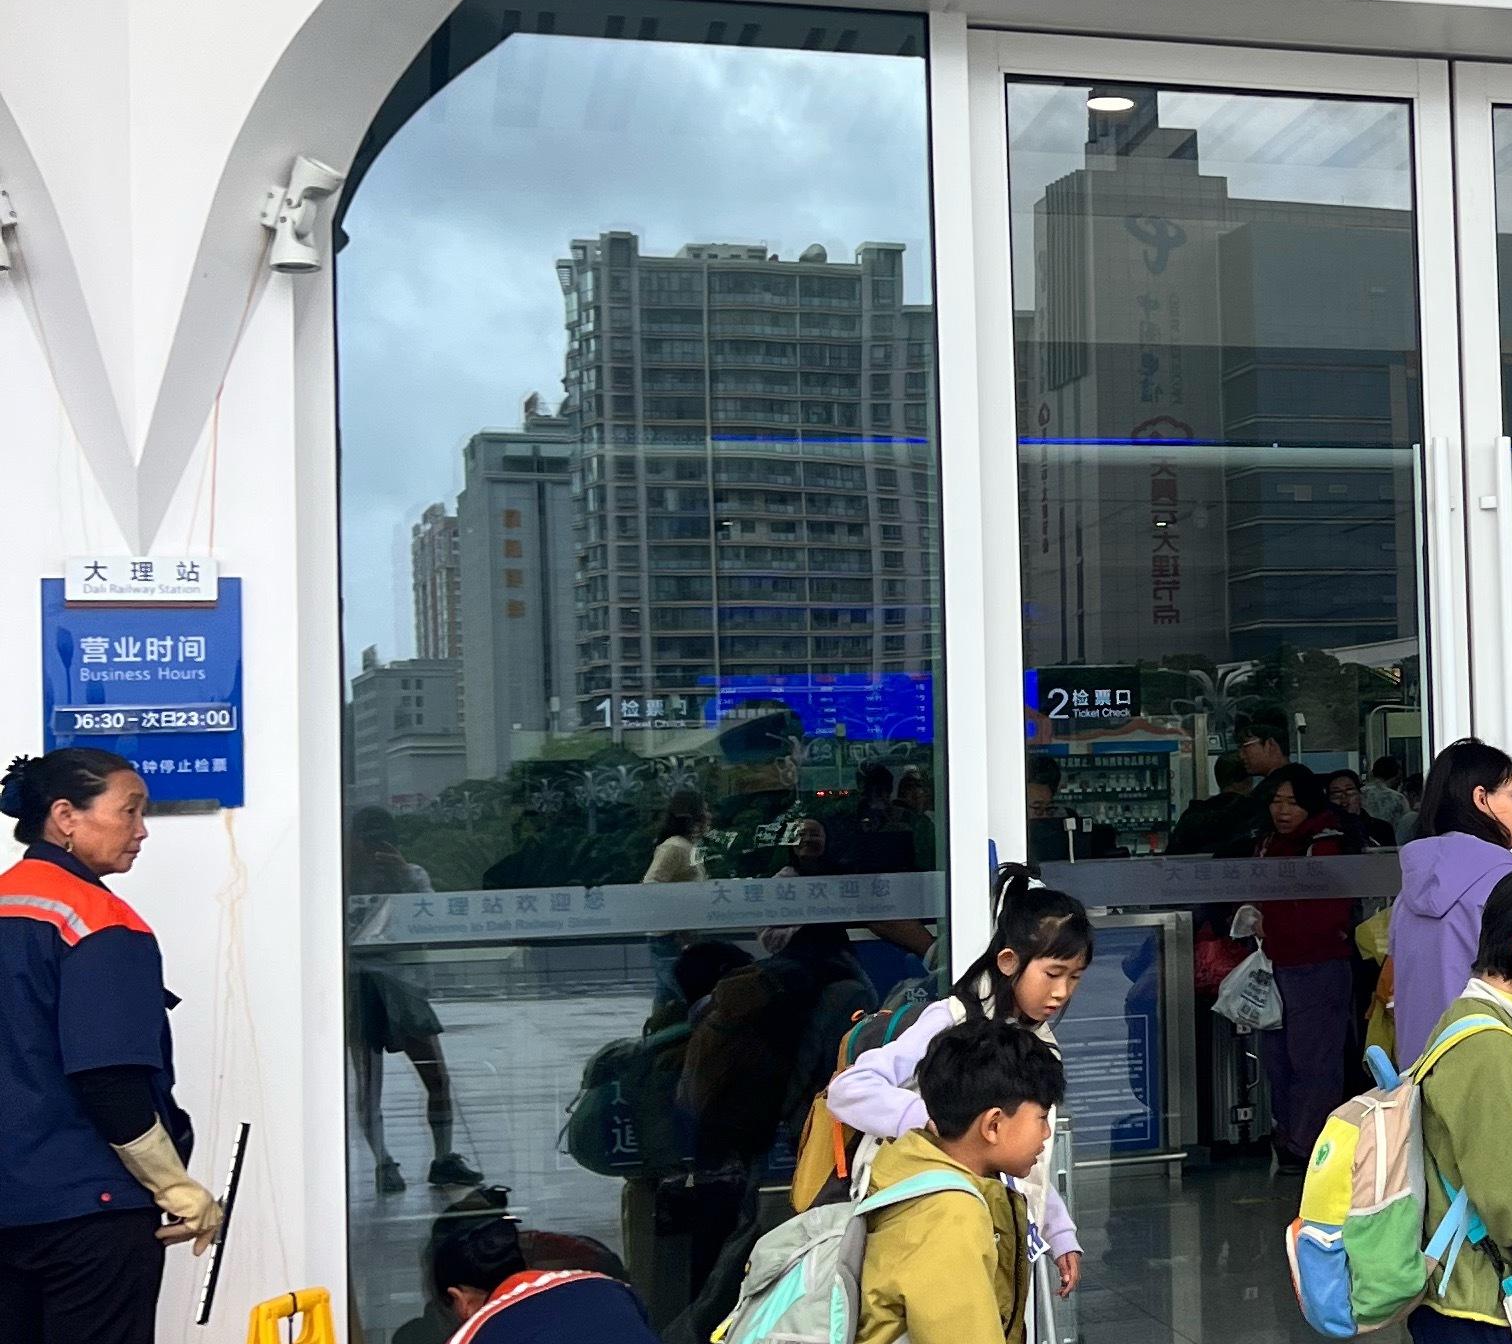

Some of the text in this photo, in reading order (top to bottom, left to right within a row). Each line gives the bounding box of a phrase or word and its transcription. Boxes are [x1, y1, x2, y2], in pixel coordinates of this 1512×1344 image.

[84, 560, 200, 582] 大理站
[83, 584, 201, 595] Dali Railway Station
[80, 635, 206, 663] 营业时间
[80, 667, 206, 681] Business Hours
[1048, 688, 1069, 719] 2
[1072, 689, 1131, 706] 检票口
[596, 698, 611, 727] 1
[1072, 708, 1131, 718] Ticket Check
[130, 757, 228, 774] 钟停止检票
[712, 879, 891, 904] 大理站欢迎您
[413, 891, 605, 917] 大理站欢迎您
